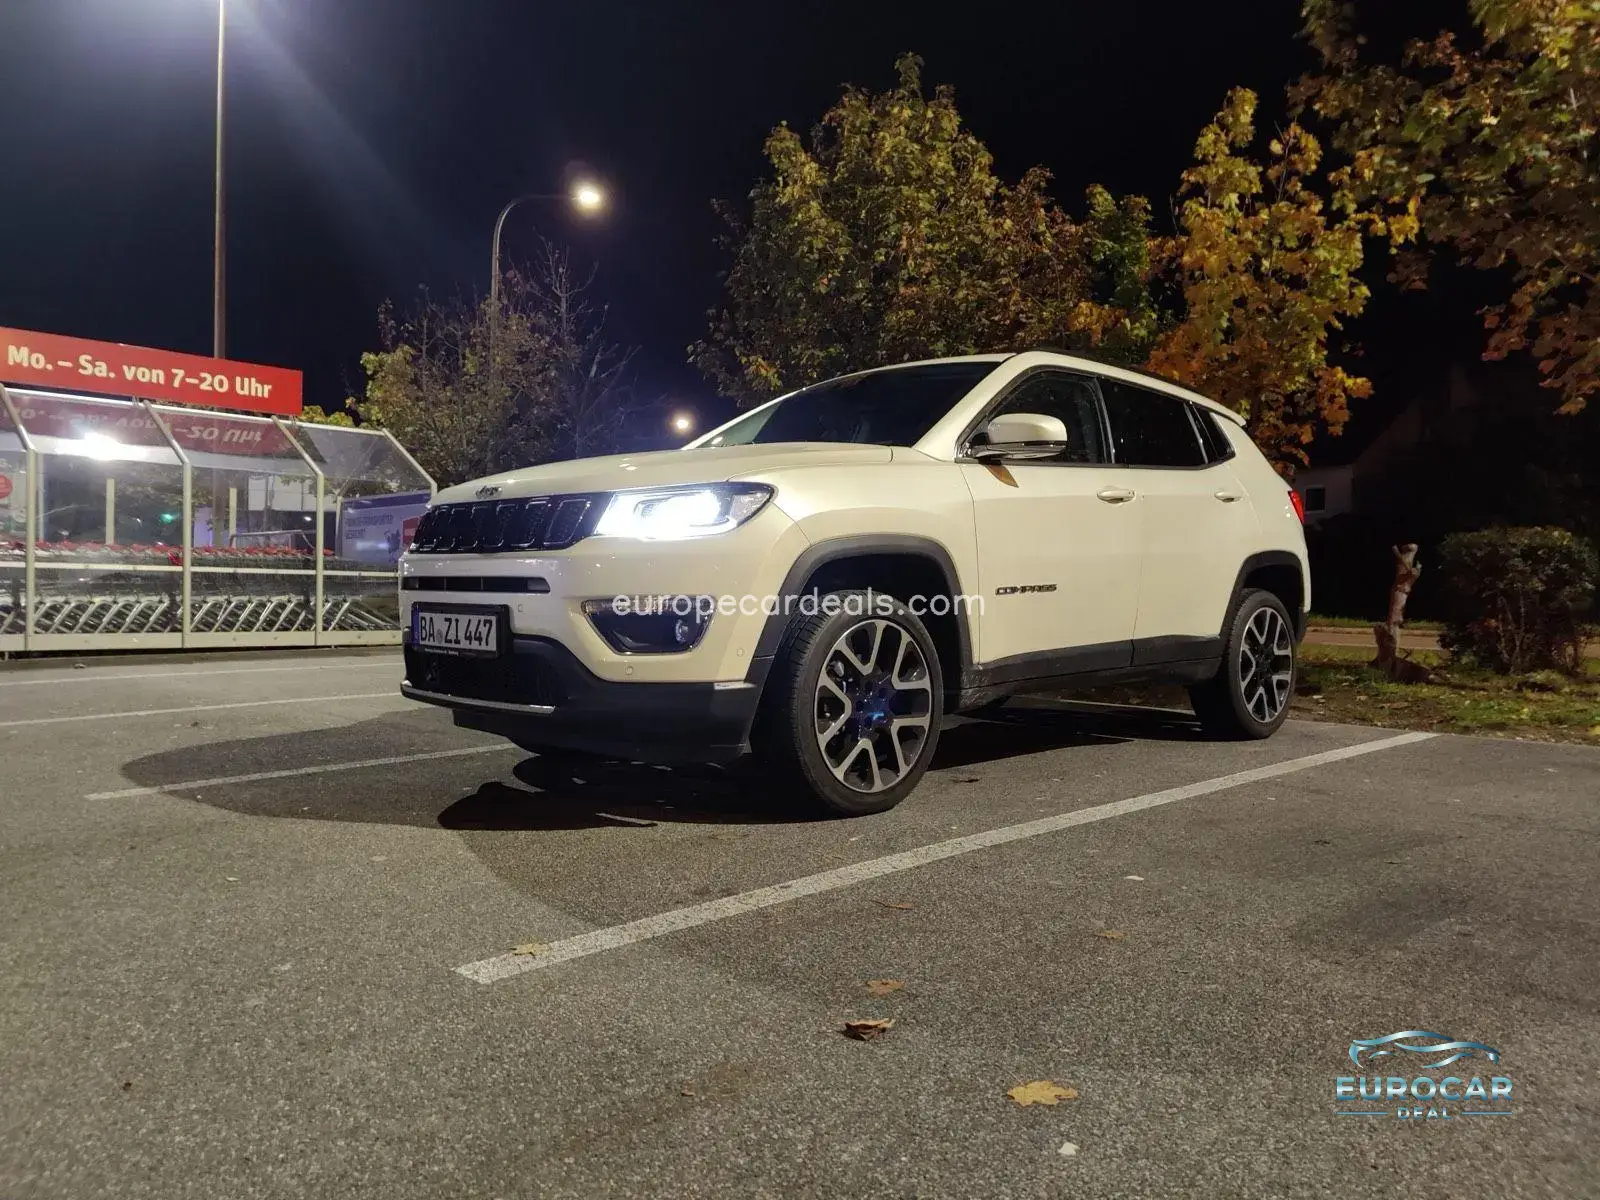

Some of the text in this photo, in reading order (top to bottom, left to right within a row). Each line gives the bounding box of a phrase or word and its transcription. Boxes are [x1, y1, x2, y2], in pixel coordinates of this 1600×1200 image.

[8, 344, 53, 370] Mo.
[78, 354, 116, 378] Sa.
[122, 364, 165, 385] von
[235, 376, 272, 399] Uhr
[995, 584, 1057, 596] COMPASS
[420, 616, 493, 647] BA ZI 447
